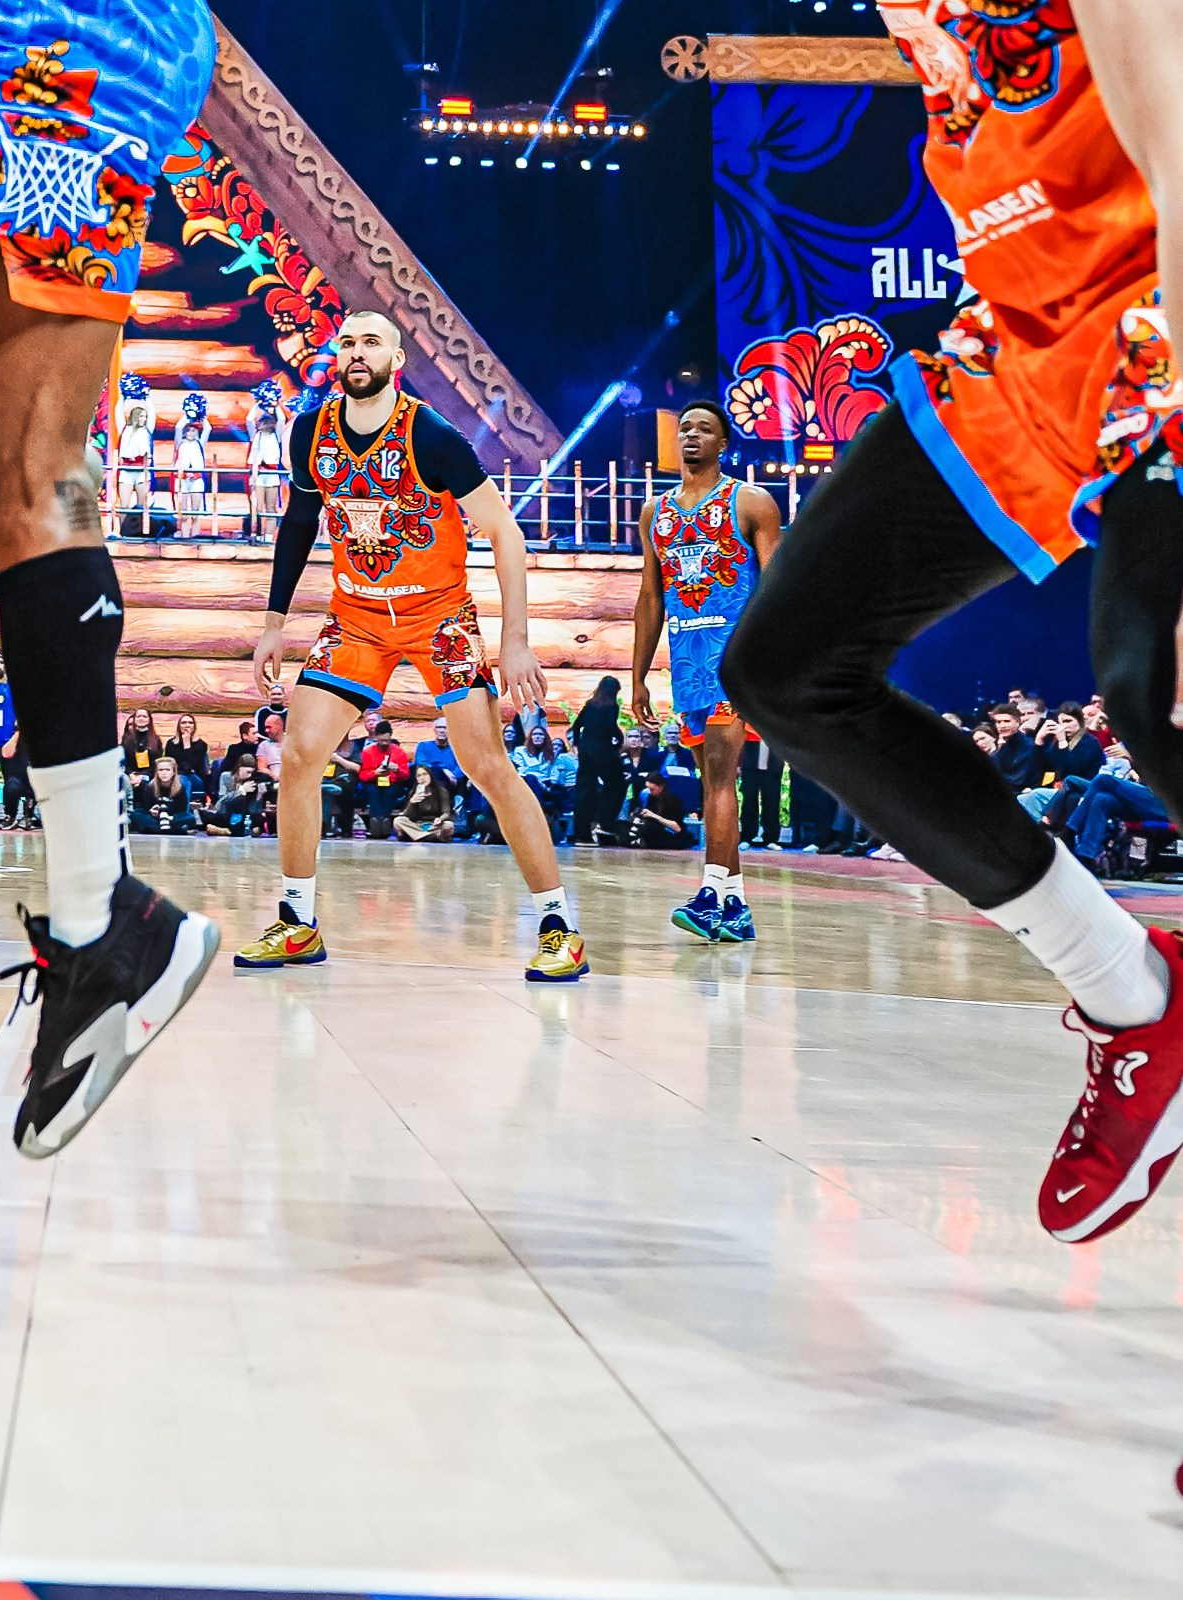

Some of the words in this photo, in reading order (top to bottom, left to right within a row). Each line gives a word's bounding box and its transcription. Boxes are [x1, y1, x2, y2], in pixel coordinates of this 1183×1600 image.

[872, 247, 947, 299] ALL
[372, 449, 401, 480] 12
[354, 583, 426, 595] КАМКАБЕЛЬ
